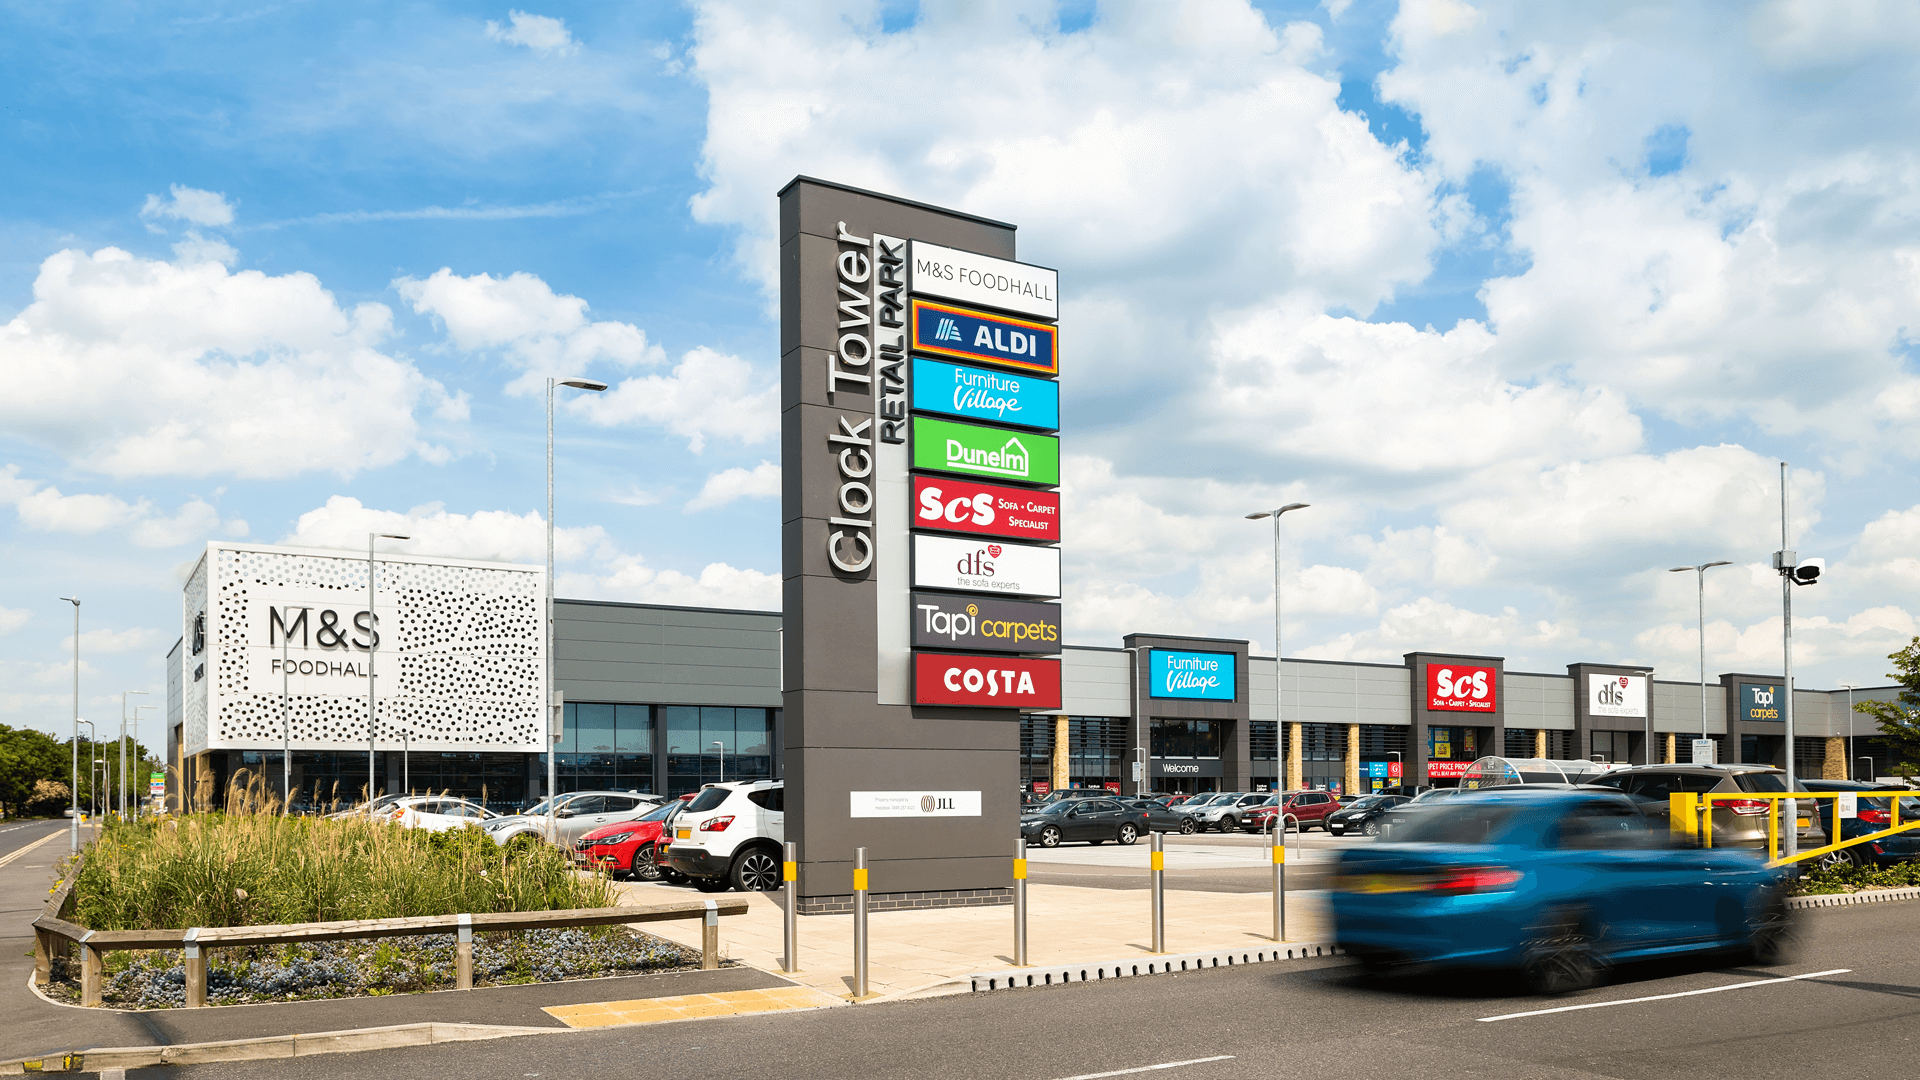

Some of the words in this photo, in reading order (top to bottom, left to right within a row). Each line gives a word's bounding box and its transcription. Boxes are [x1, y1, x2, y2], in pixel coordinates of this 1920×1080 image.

[879, 239, 904, 328] PARK
[917, 258, 953, 281] M&S
[959, 267, 1053, 302] FOODHALL
[826, 221, 872, 394] Tower
[974, 325, 1036, 357] ALDI
[880, 335, 905, 443] RETAIL
[954, 368, 1020, 393] Furniture
[953, 385, 1022, 417] Village
[946, 439, 1024, 470] Dunelm
[827, 415, 874, 573] Clock
[918, 486, 996, 526] ScS
[1008, 516, 1049, 530] SPECIALIST
[957, 550, 995, 577] dfs
[957, 577, 970, 586] the
[972, 577, 989, 588] sofa
[991, 579, 1020, 590] experts
[269, 605, 380, 650] M&S
[917, 603, 979, 641] Tapi
[981, 619, 1057, 643] carpets
[271, 659, 379, 677] FOODHALL
[1167, 655, 1218, 671] Furniture
[943, 667, 1036, 697] COSTA
[1166, 670, 1220, 694] Village
[1436, 668, 1488, 699] ScS
[1598, 681, 1623, 706] dfs
[1608, 706, 1619, 714] sofa
[1620, 707, 1639, 715] experts
[1751, 686, 1774, 708] Tapi
[1750, 707, 1779, 720] carpets
[1162, 763, 1200, 773] Welcome
[1439, 763, 1454, 771] PRICE
[936, 798, 955, 810] JLL
